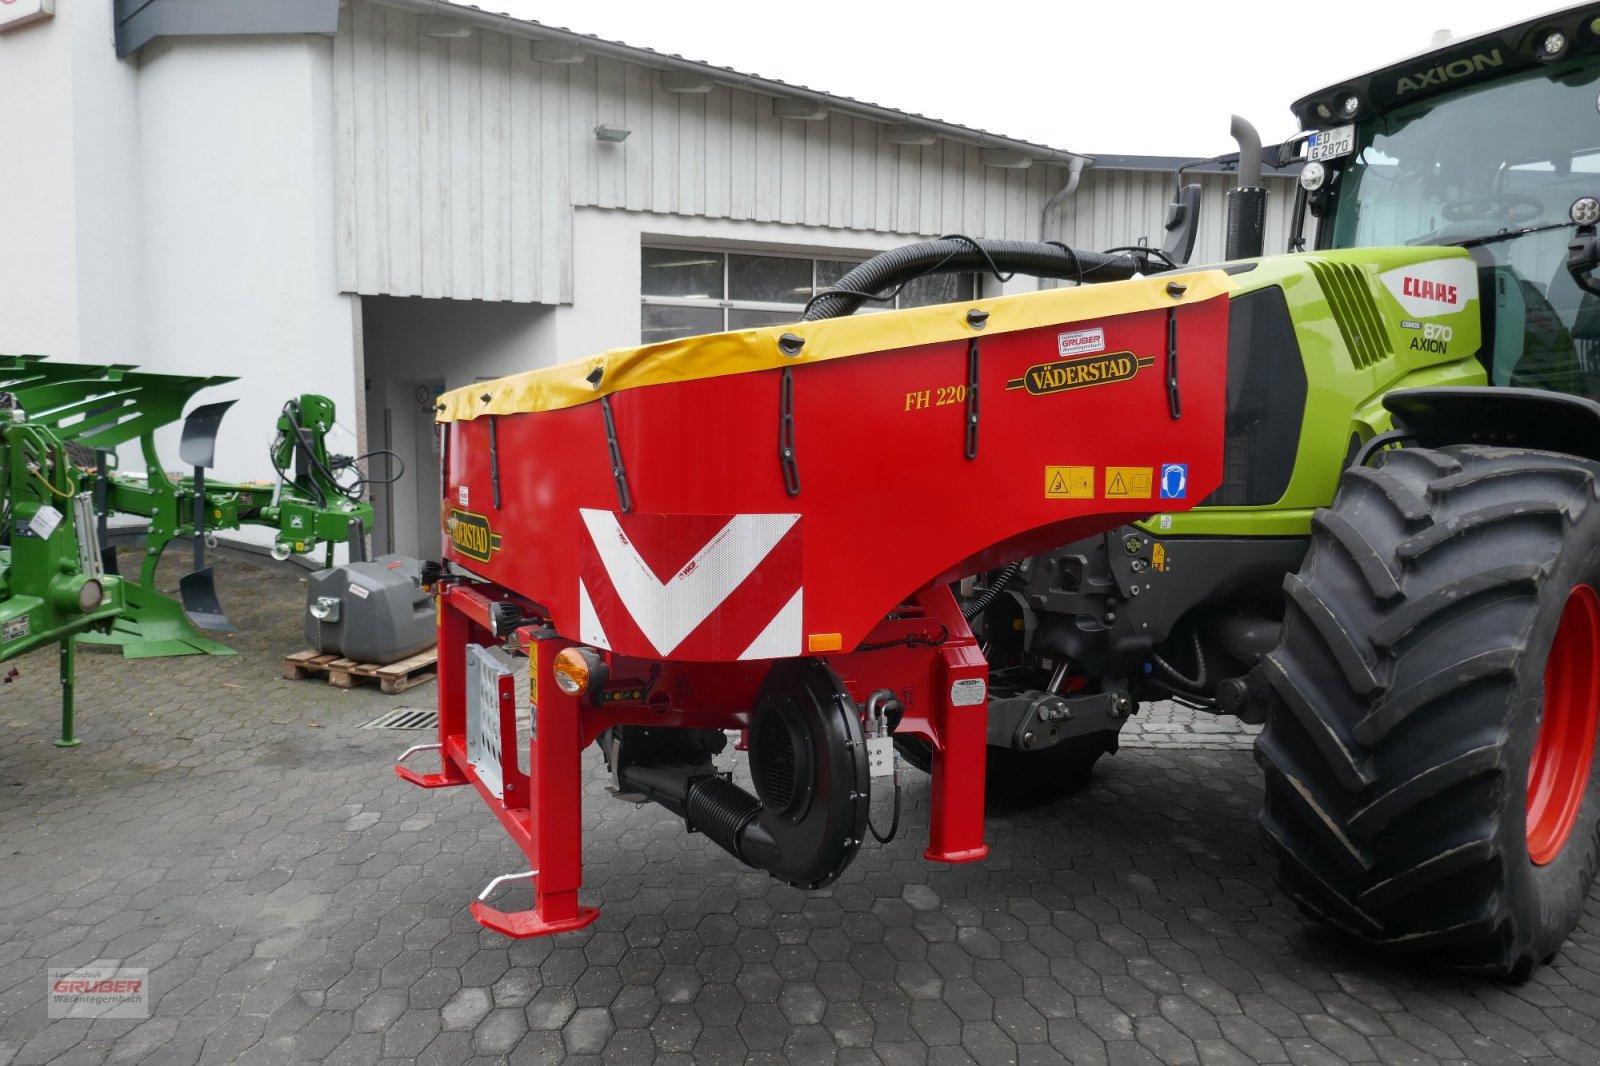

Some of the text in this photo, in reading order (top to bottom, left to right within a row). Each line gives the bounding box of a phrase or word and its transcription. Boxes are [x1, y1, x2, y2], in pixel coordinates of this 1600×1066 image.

[1396, 49, 1504, 96] AXION
[1312, 139, 1349, 159] G 2870
[1316, 132, 1330, 146] ED
[1402, 276, 1457, 304] CLAAS
[1062, 335, 1100, 348] GRUBER
[1423, 323, 1453, 342] 870
[1409, 336, 1447, 354] AXION
[1032, 358, 1131, 390] VÄDERSTAD
[904, 390, 931, 412] FH
